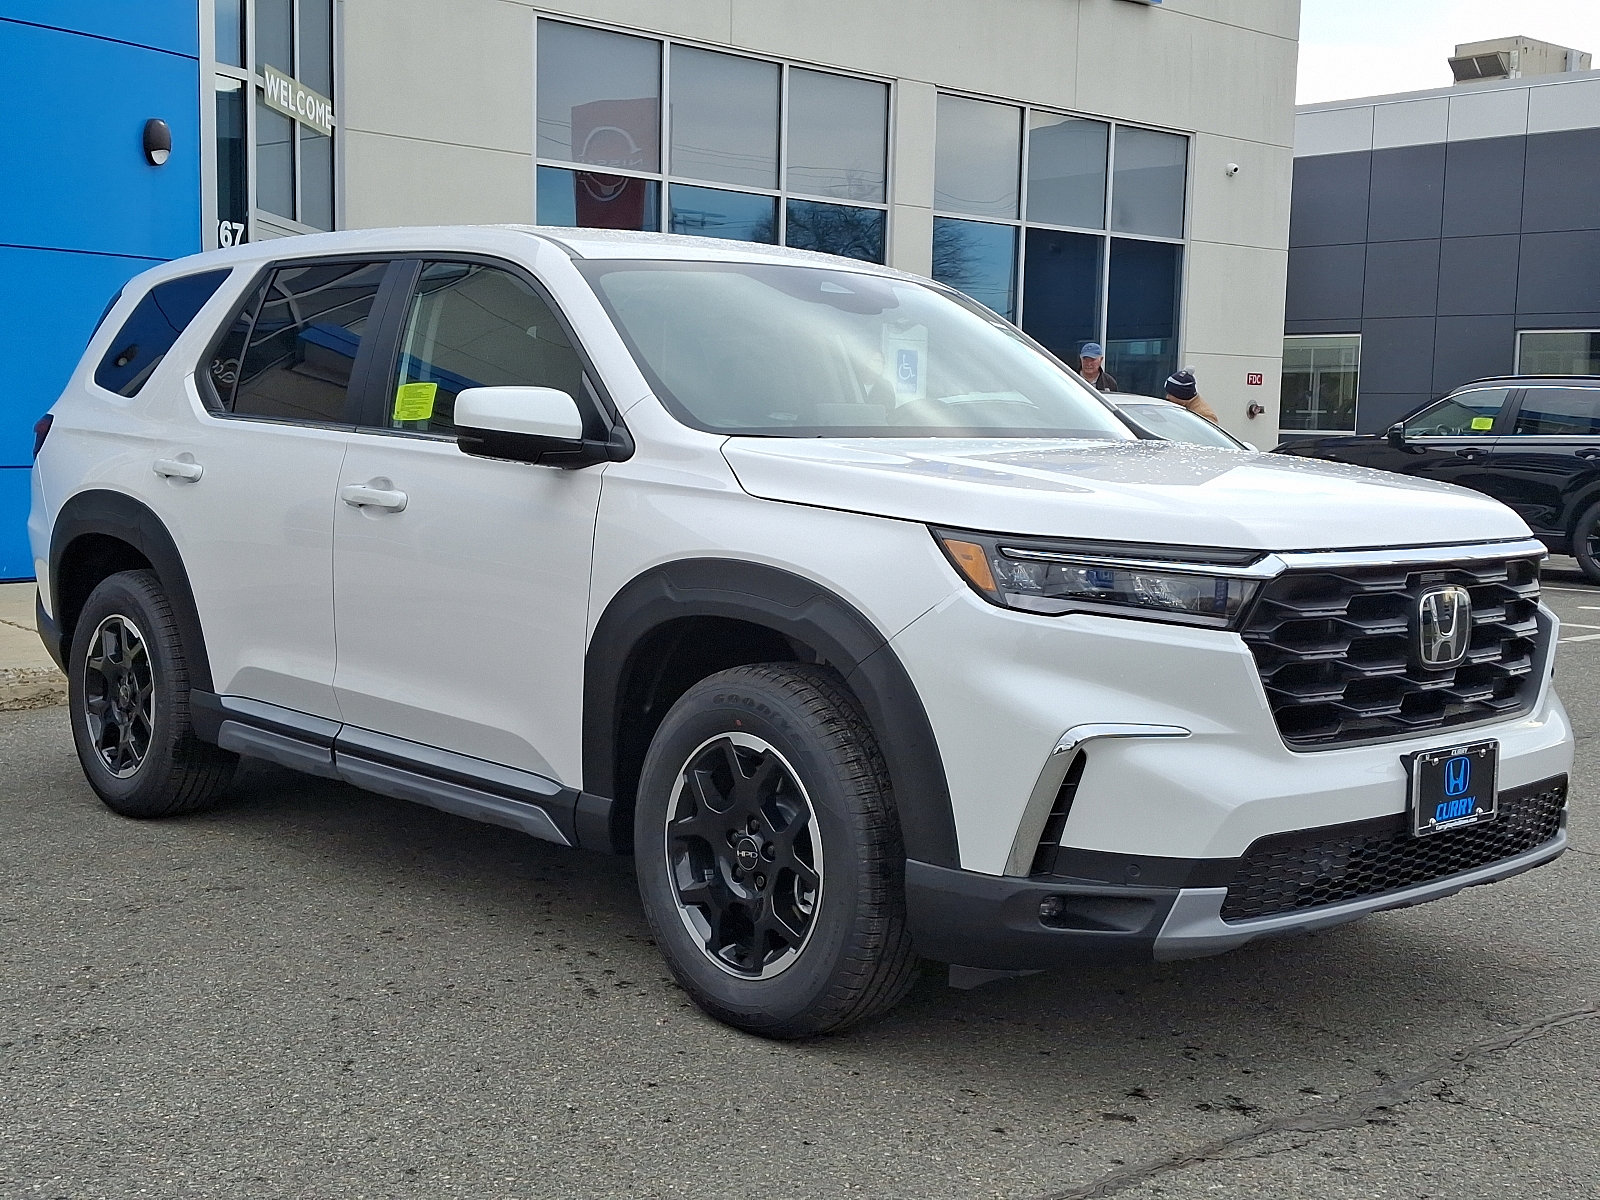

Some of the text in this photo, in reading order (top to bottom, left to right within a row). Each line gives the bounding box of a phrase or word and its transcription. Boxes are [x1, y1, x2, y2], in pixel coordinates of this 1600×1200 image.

[264, 71, 332, 128] WELCOME
[217, 219, 245, 248] 67
[1248, 374, 1262, 384] FDC
[1435, 795, 1476, 822] CURRY
[736, 850, 758, 859] HPD
